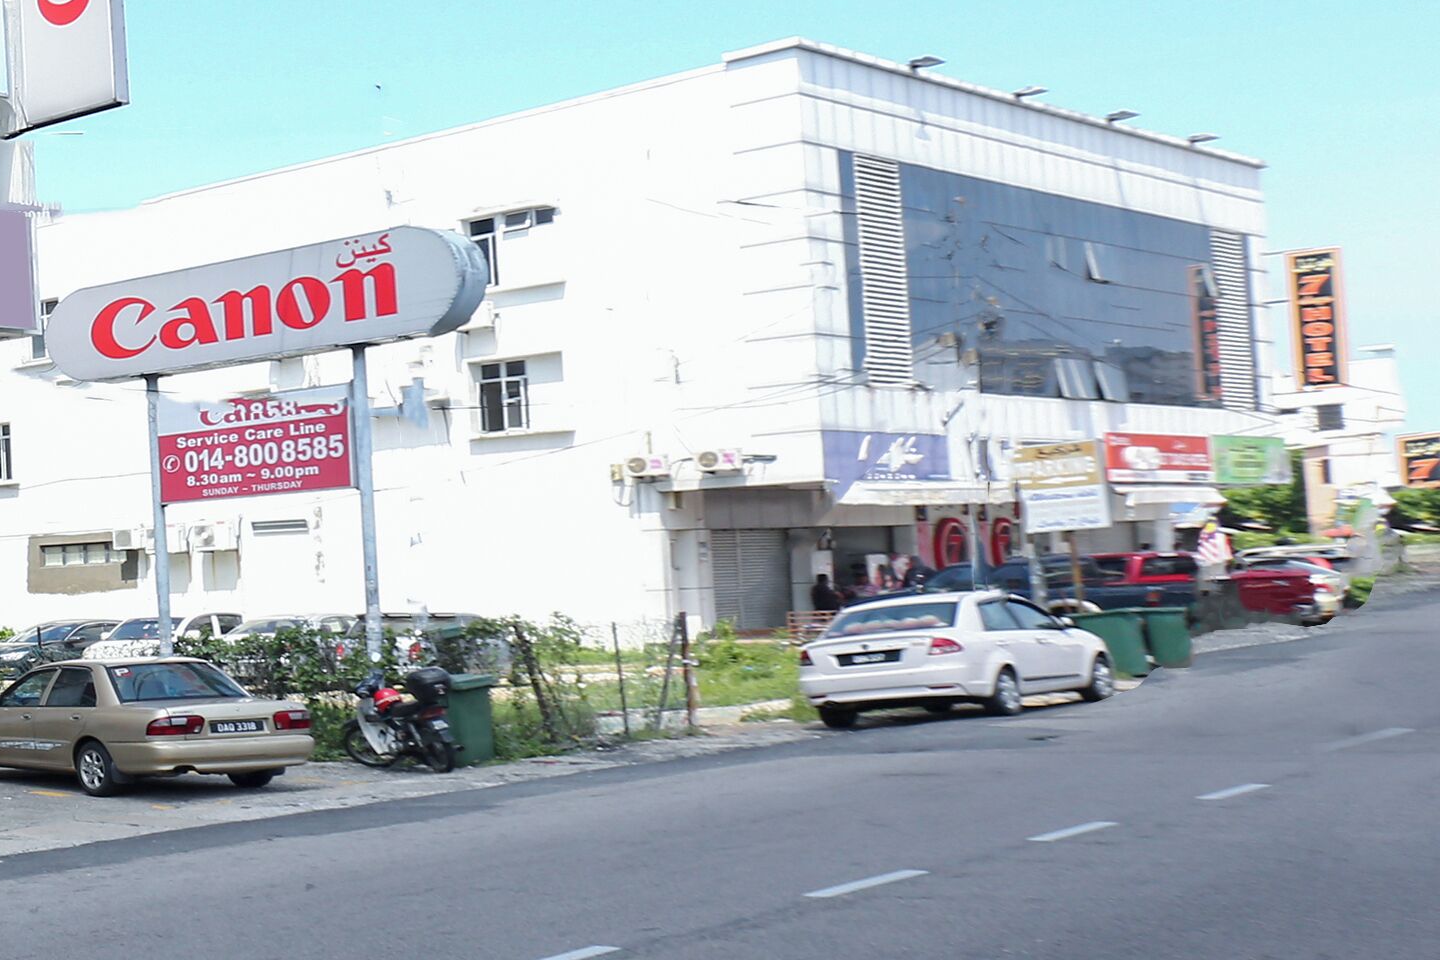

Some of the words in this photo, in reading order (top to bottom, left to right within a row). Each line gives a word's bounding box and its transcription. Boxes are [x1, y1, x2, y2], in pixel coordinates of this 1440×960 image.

[91, 262, 399, 360] Canon
[176, 432, 239, 449] Service
[245, 426, 284, 440] Care
[290, 422, 326, 436] Line
[187, 472, 243, 487] 8.30am
[260, 465, 320, 480] 9.00pm
[202, 486, 239, 497] SUNDAY
[251, 480, 303, 492] THURSDAY
